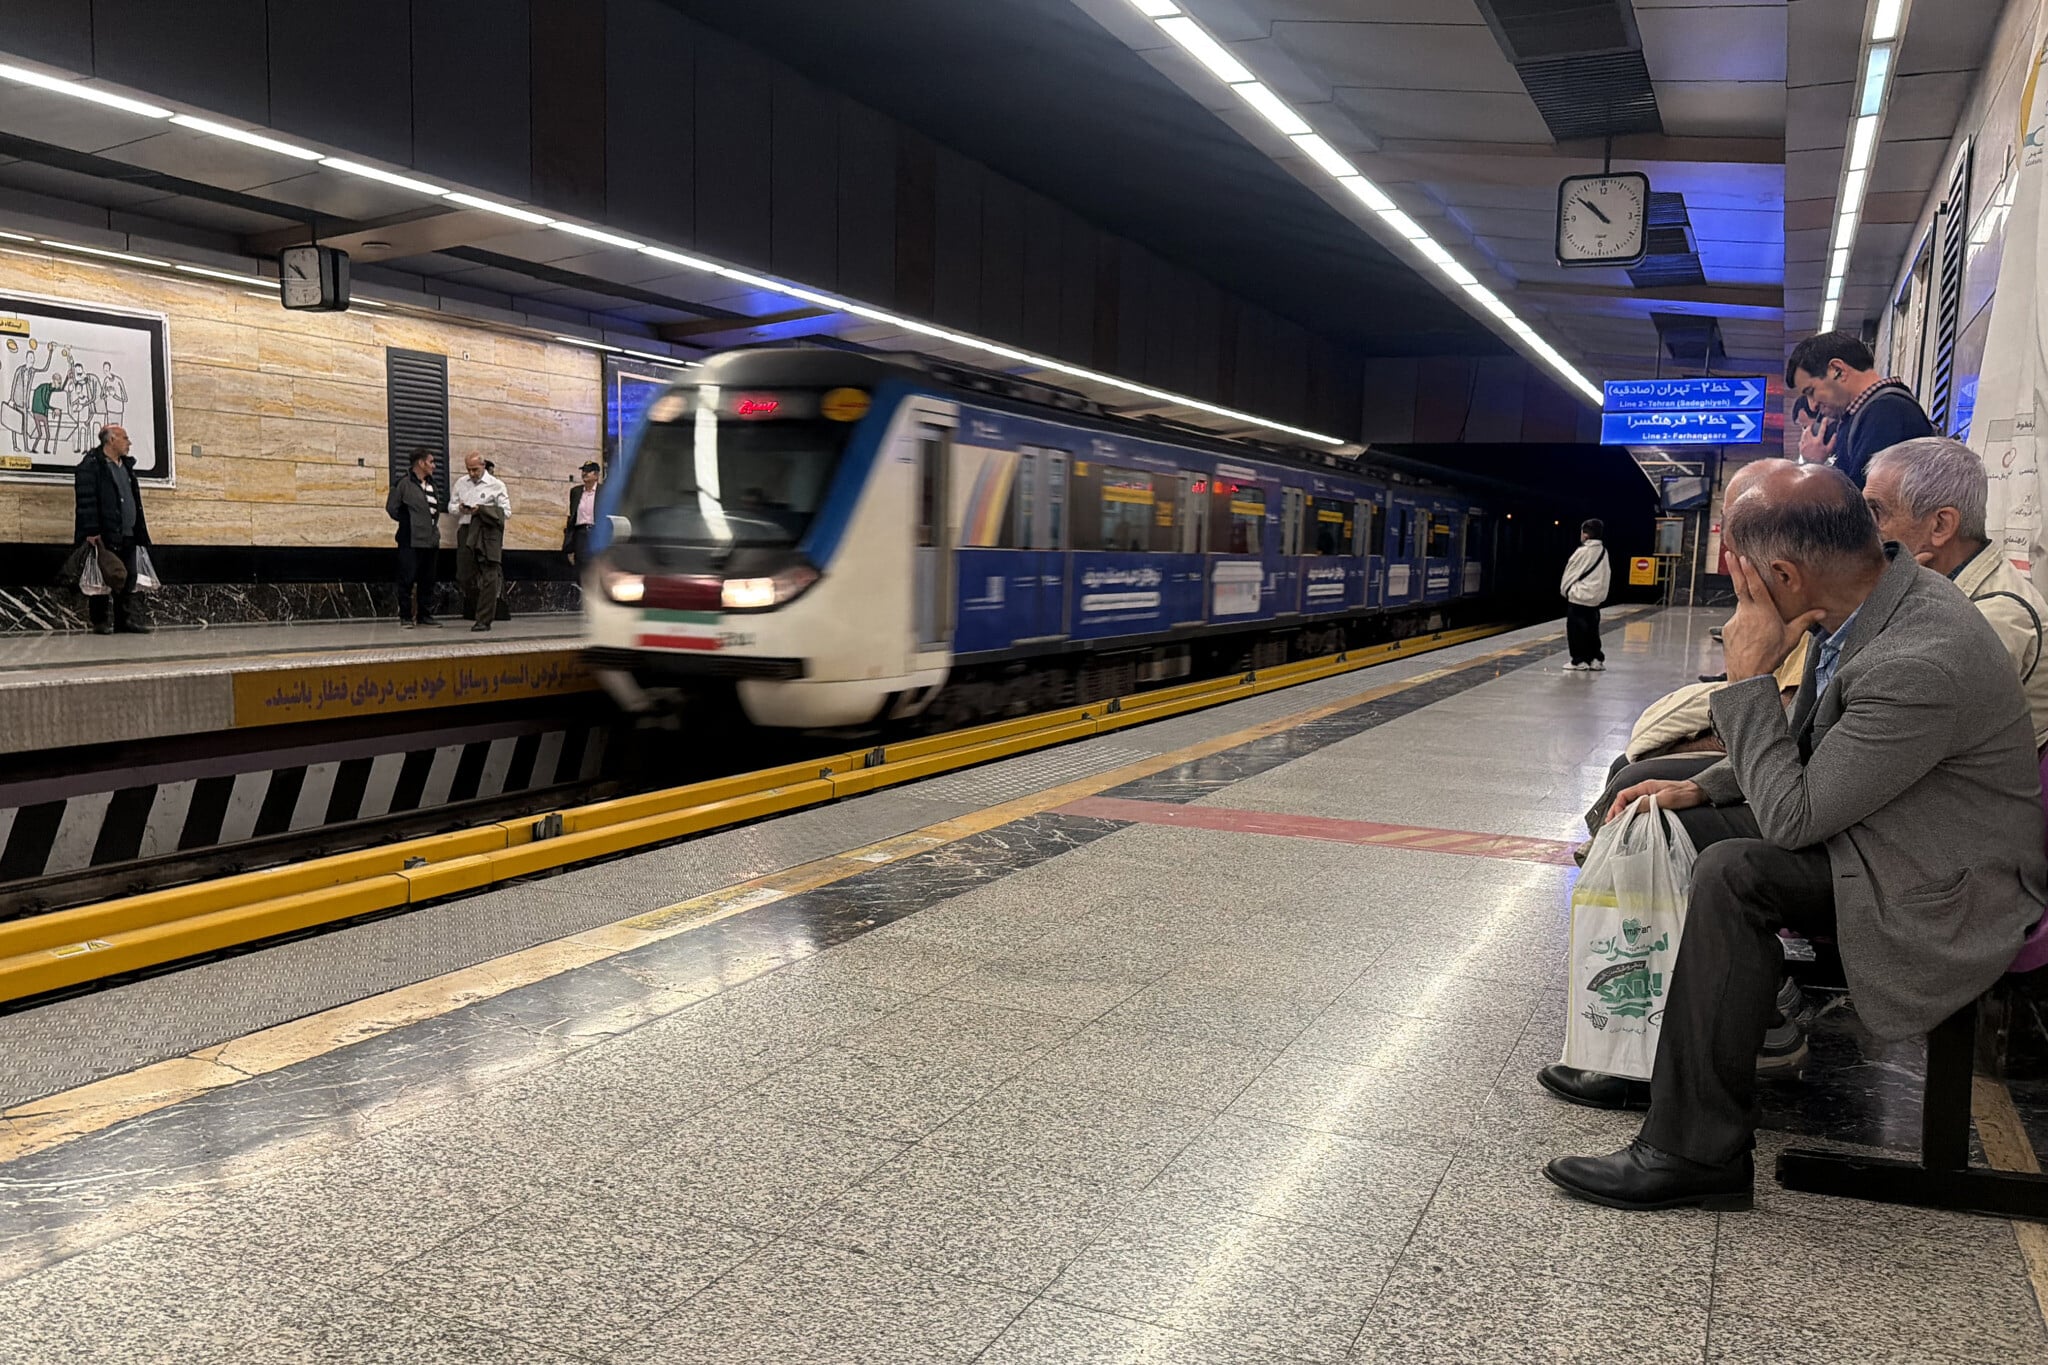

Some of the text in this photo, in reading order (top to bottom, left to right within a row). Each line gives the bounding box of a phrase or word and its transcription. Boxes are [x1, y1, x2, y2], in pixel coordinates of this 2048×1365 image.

[1600, 187, 1608, 195] 12
[1608, 384, 1655, 396] (صادقیه)
[1657, 384, 1690, 396] تهران
[1648, 400, 1675, 408] Tehran
[1627, 415, 1687, 428] فرهنگسرا
[421, 671, 446, 700] خود
